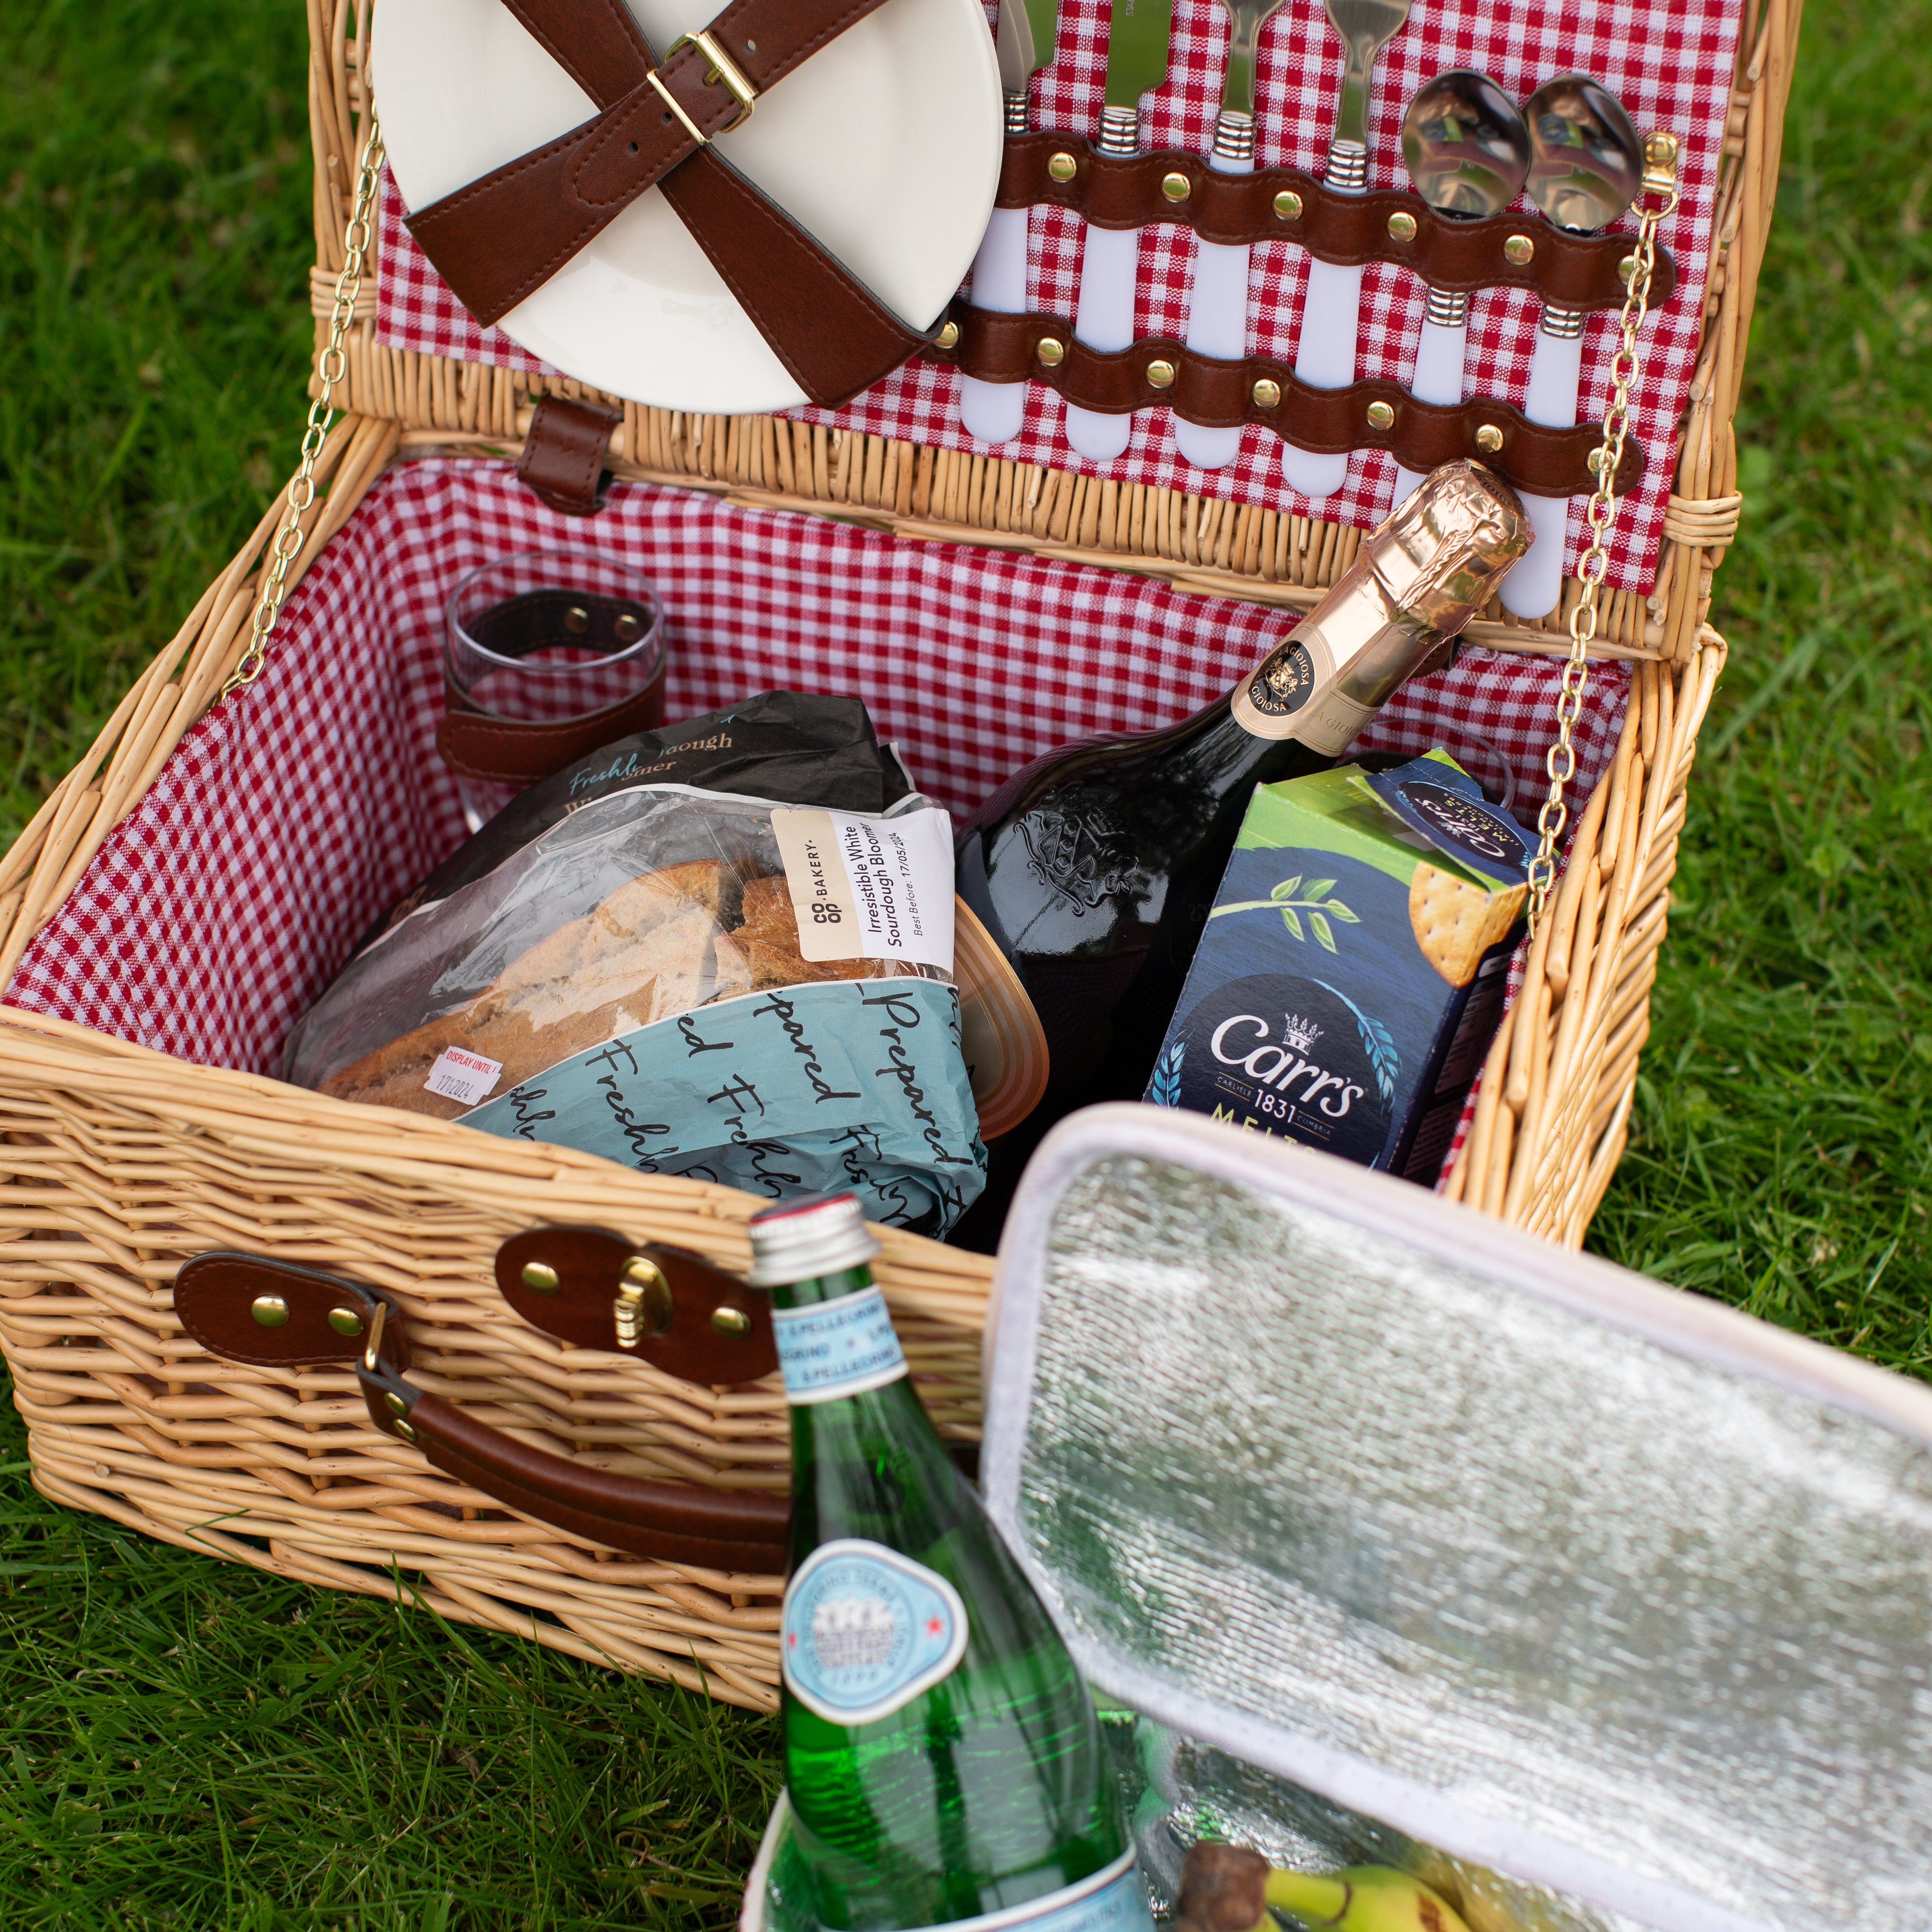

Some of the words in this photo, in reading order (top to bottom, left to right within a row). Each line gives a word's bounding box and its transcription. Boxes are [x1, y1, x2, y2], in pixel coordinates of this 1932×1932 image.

[1279, 648, 1289, 656] LA
[1290, 646, 1309, 686] GIOIOSA
[1250, 685, 1286, 712] GIOIOSA
[1445, 800, 1507, 841] MELTS
[1456, 814, 1480, 831] 1831
[845, 826, 864, 862] White
[860, 823, 885, 865] Bloomer
[888, 832, 910, 877] 17/05/2024
[854, 864, 882, 933] Irresistible
[873, 869, 901, 947] Sourdough
[905, 880, 919, 913] Before:
[913, 914, 923, 937] Best
[446, 1051, 473, 1067] DISPLAY
[472, 1060, 492, 1074] UNTIL
[861, 992, 973, 1165] Prepared
[1210, 1014, 1364, 1117] Carr's
[1217, 1076, 1252, 1097] CARLISLE
[1254, 1088, 1296, 1124] 1831
[1297, 1114, 1332, 1136] CUMBRIA
